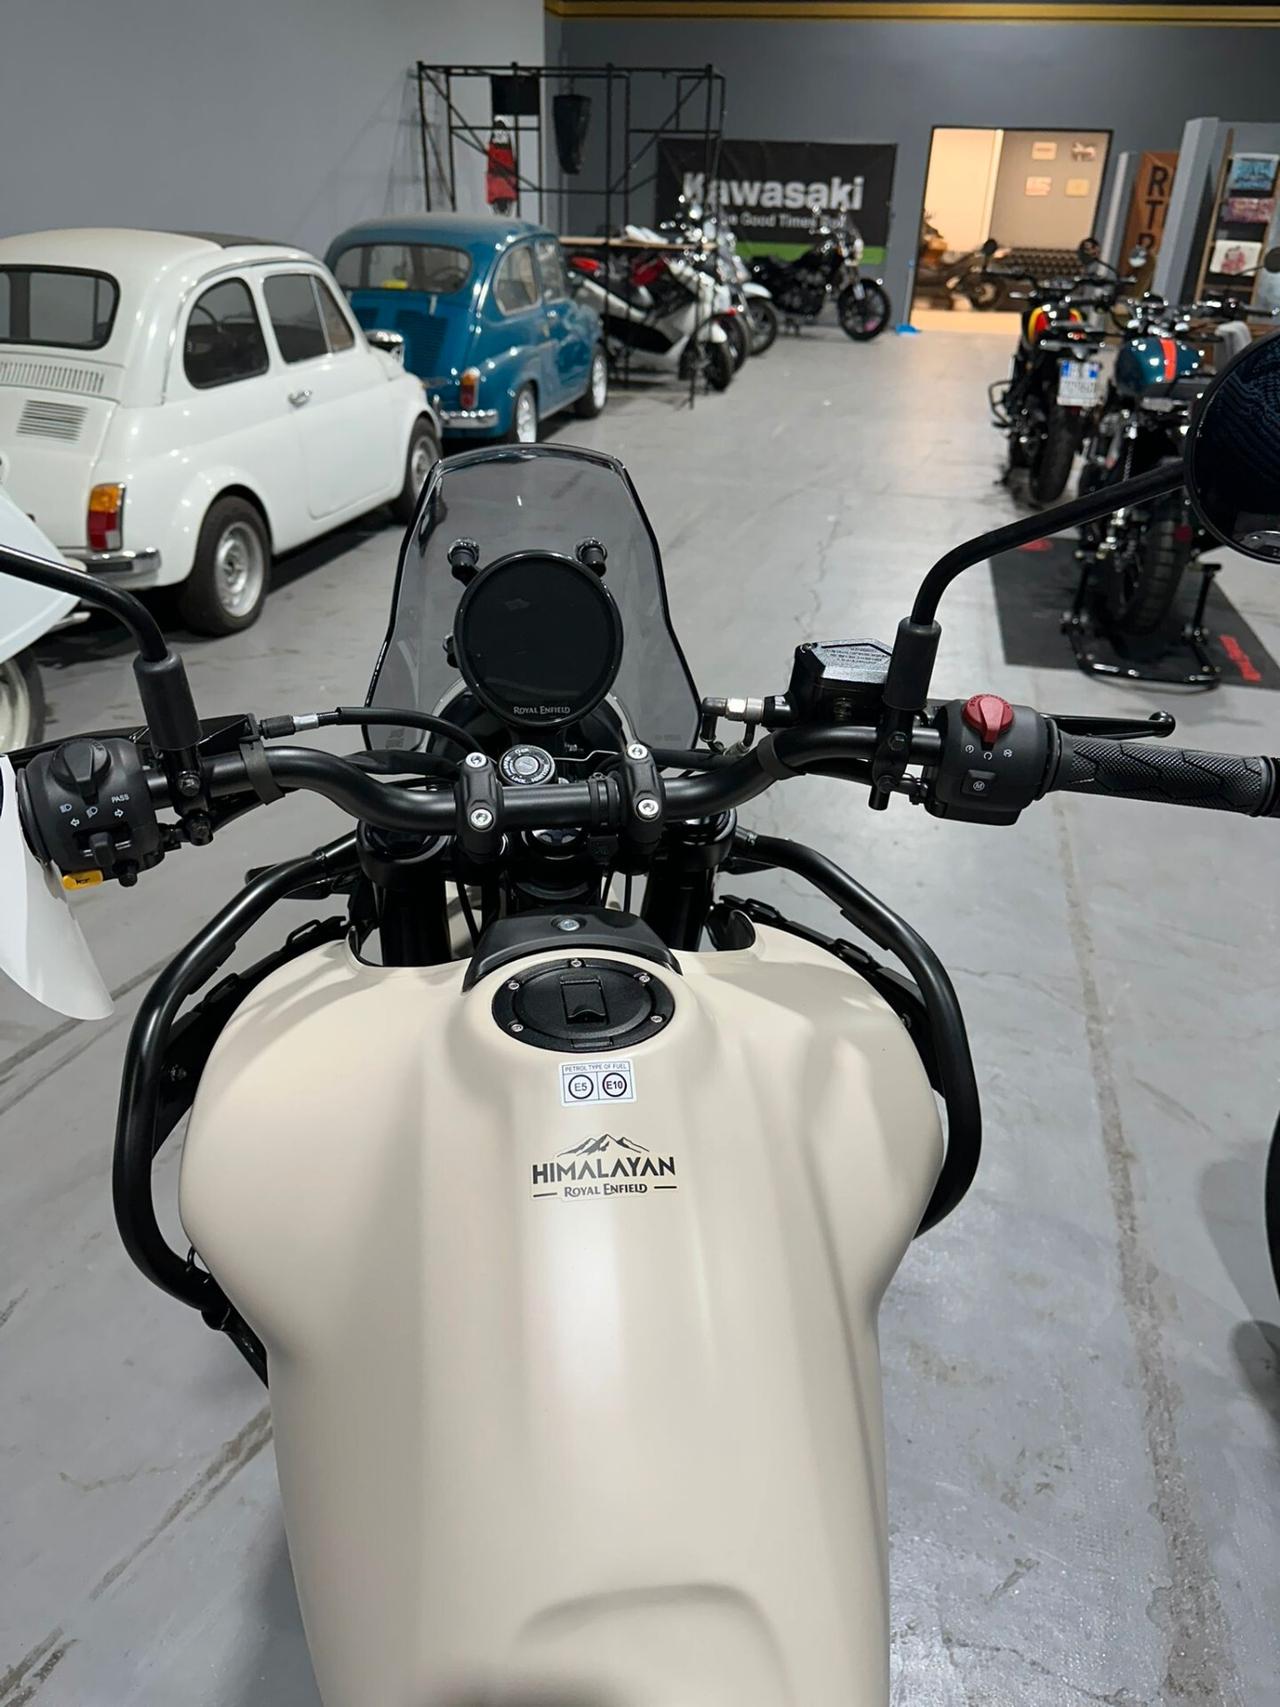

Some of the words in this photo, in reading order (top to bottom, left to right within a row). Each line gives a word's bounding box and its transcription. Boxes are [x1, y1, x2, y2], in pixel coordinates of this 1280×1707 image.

[683, 172, 864, 210] Kawasaki
[740, 212, 776, 227] Good
[111, 794, 129, 803] PASS
[574, 1082, 588, 1092] E5
[606, 1080, 624, 1090] E10
[532, 1156, 676, 1185] HIMALAYAN
